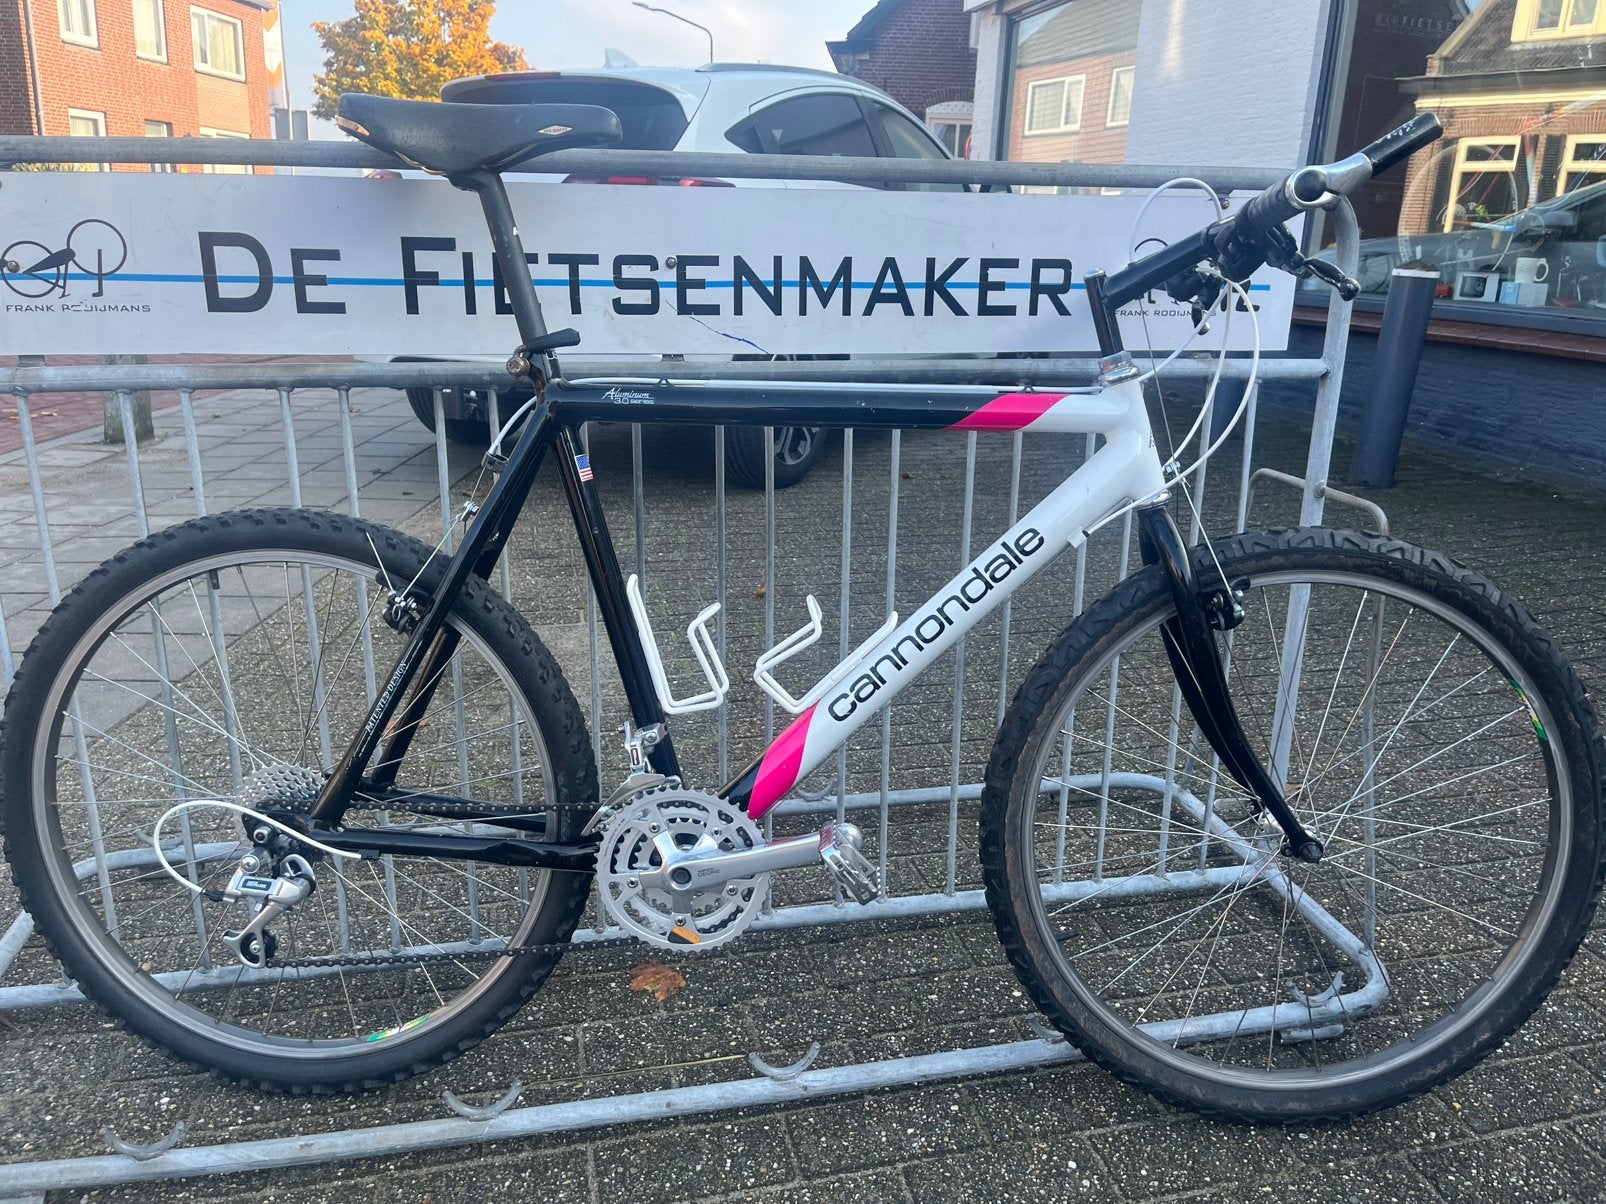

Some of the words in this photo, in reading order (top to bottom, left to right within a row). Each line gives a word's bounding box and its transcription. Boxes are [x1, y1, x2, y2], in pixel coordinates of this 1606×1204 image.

[198, 231, 347, 314] DE
[6, 304, 55, 312] FRANK
[601, 387, 654, 399] Aluminum
[827, 527, 1045, 722] cannondale
[387, 661, 407, 691] DESIGN
